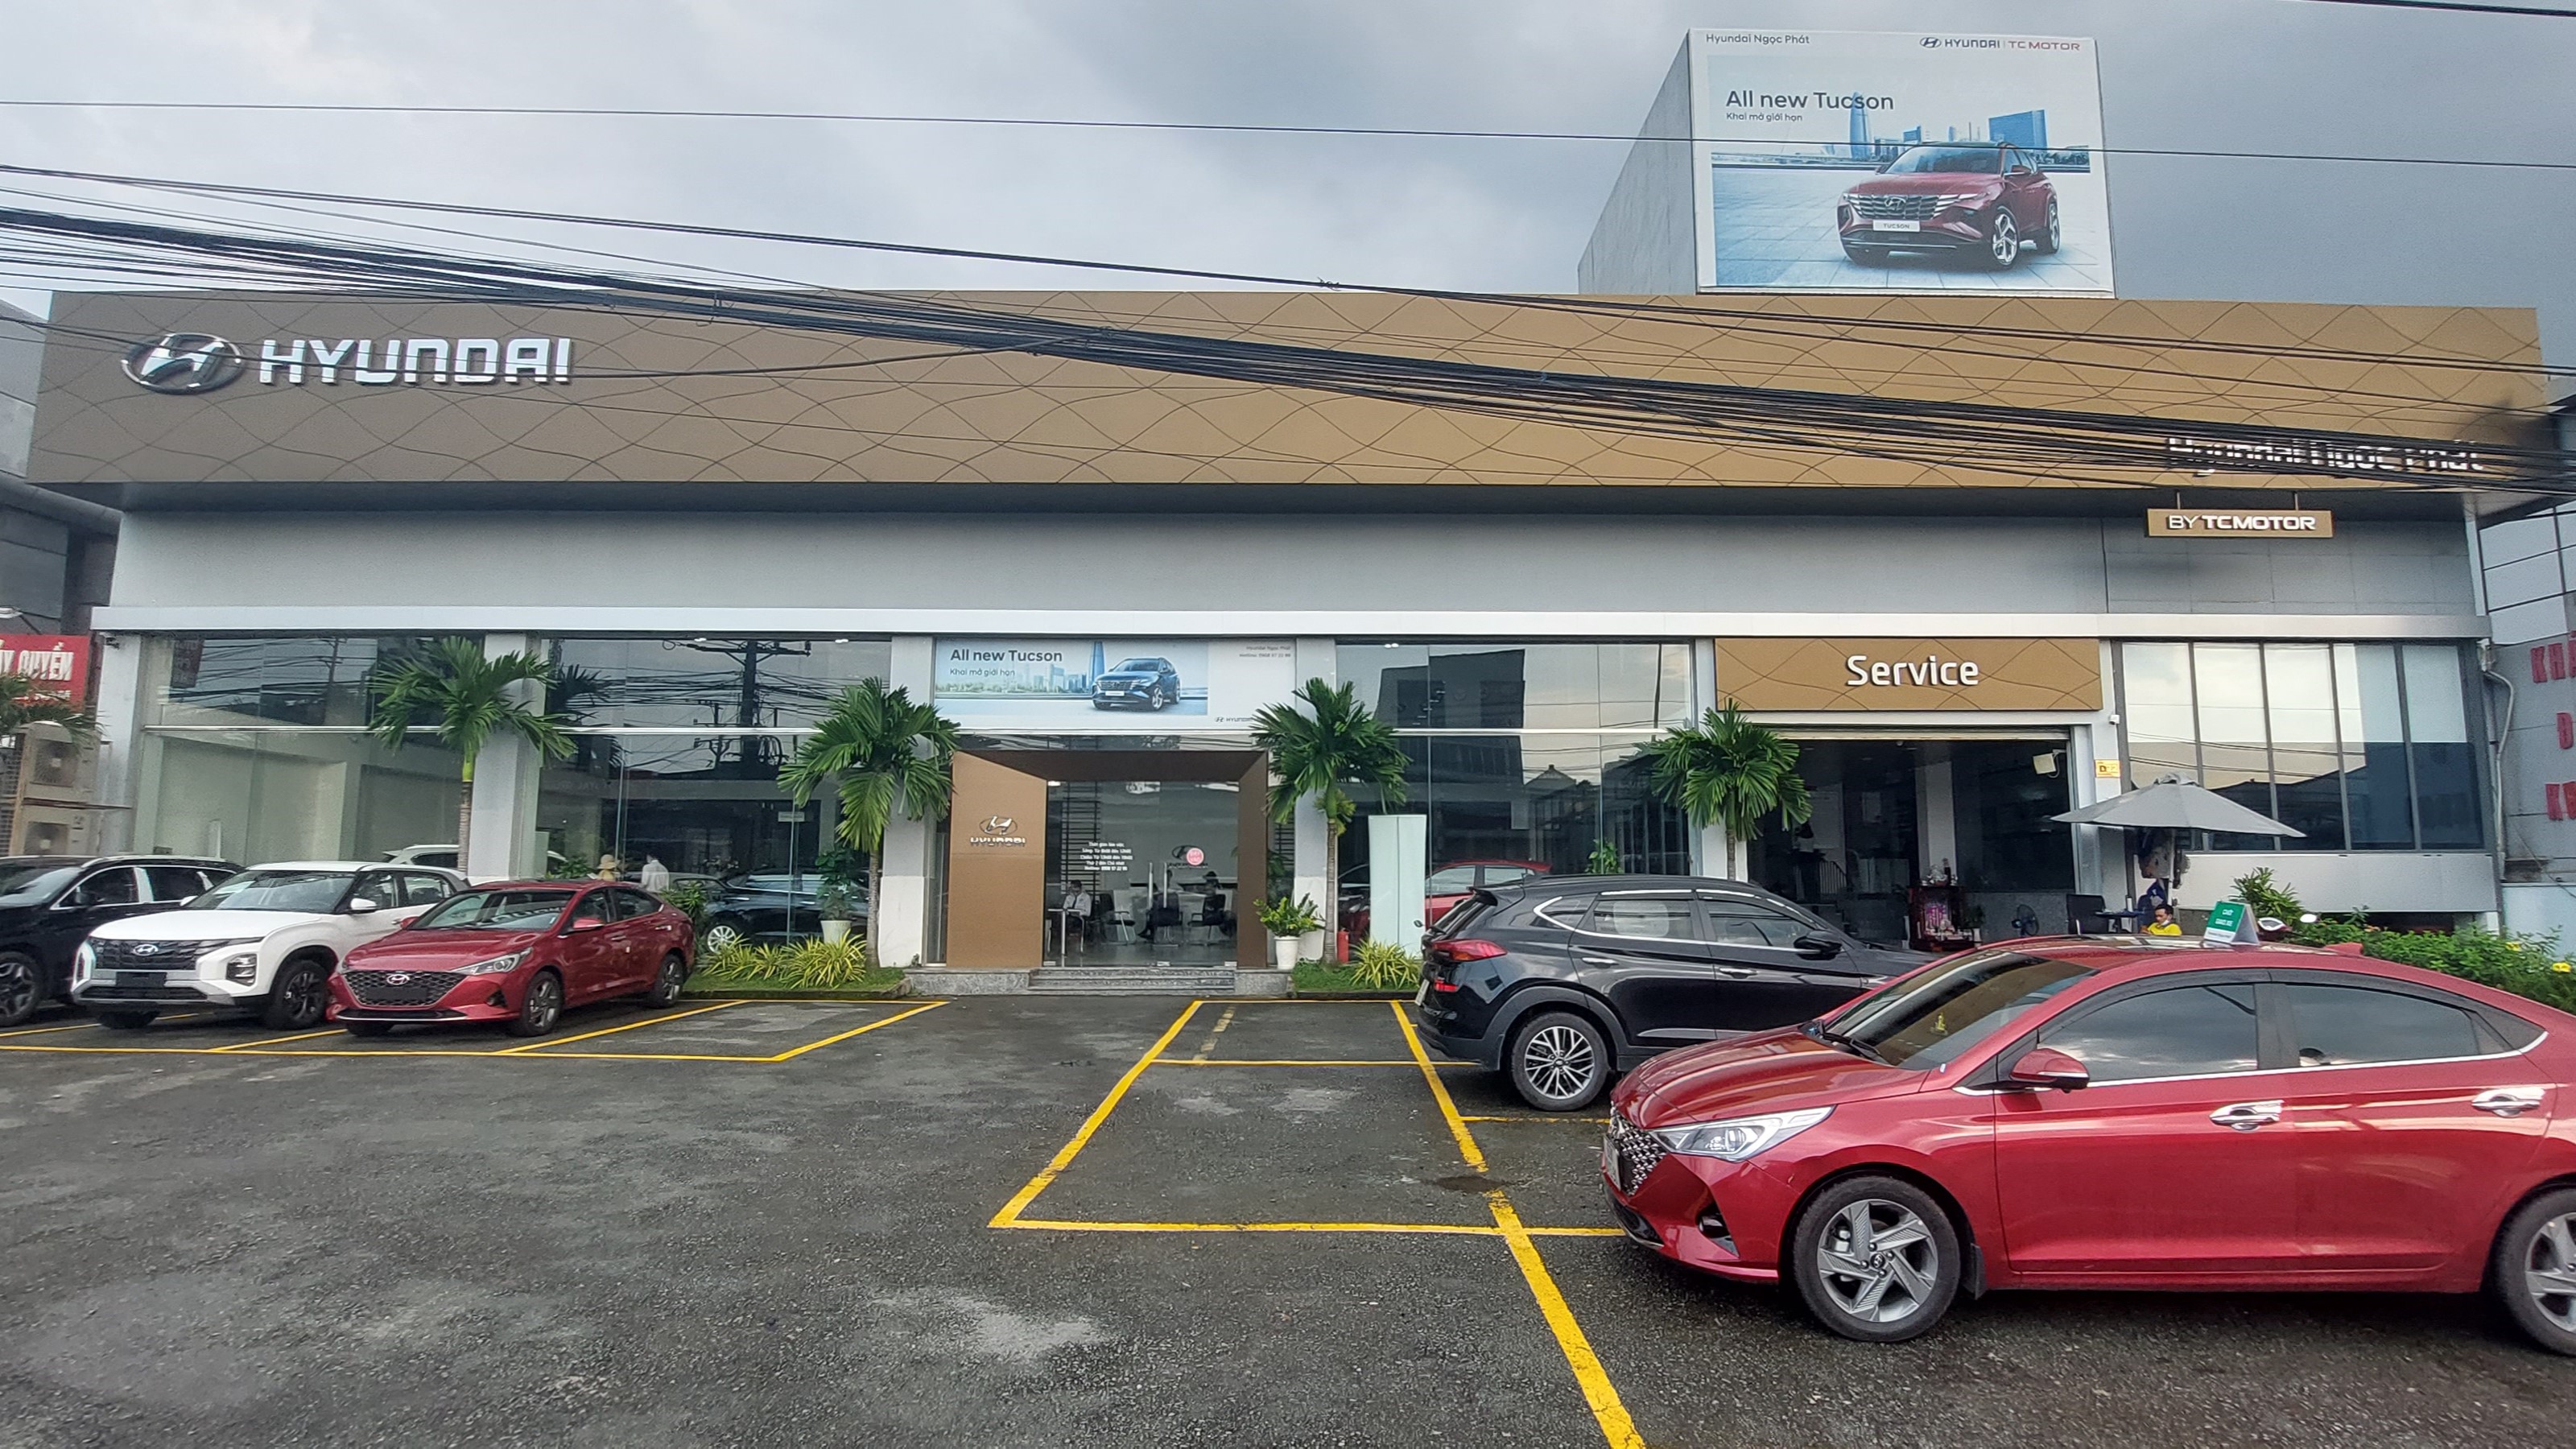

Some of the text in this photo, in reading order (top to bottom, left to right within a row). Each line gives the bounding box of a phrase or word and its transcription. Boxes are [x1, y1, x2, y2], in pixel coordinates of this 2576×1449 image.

[1706, 34, 1810, 45] Hyundai Ngọc Phát
[1945, 39, 2000, 48] HYUNDAI
[1726, 90, 1894, 109] All new Tucson
[1727, 112, 1802, 122] Khai mở giới hạn
[259, 339, 571, 383] HYUNDAI
[2169, 514, 2199, 529] BY
[950, 649, 1063, 662] All new Tucson
[950, 667, 967, 676] Khai
[1000, 667, 1015, 677] hạn
[1847, 655, 1979, 685] Service
